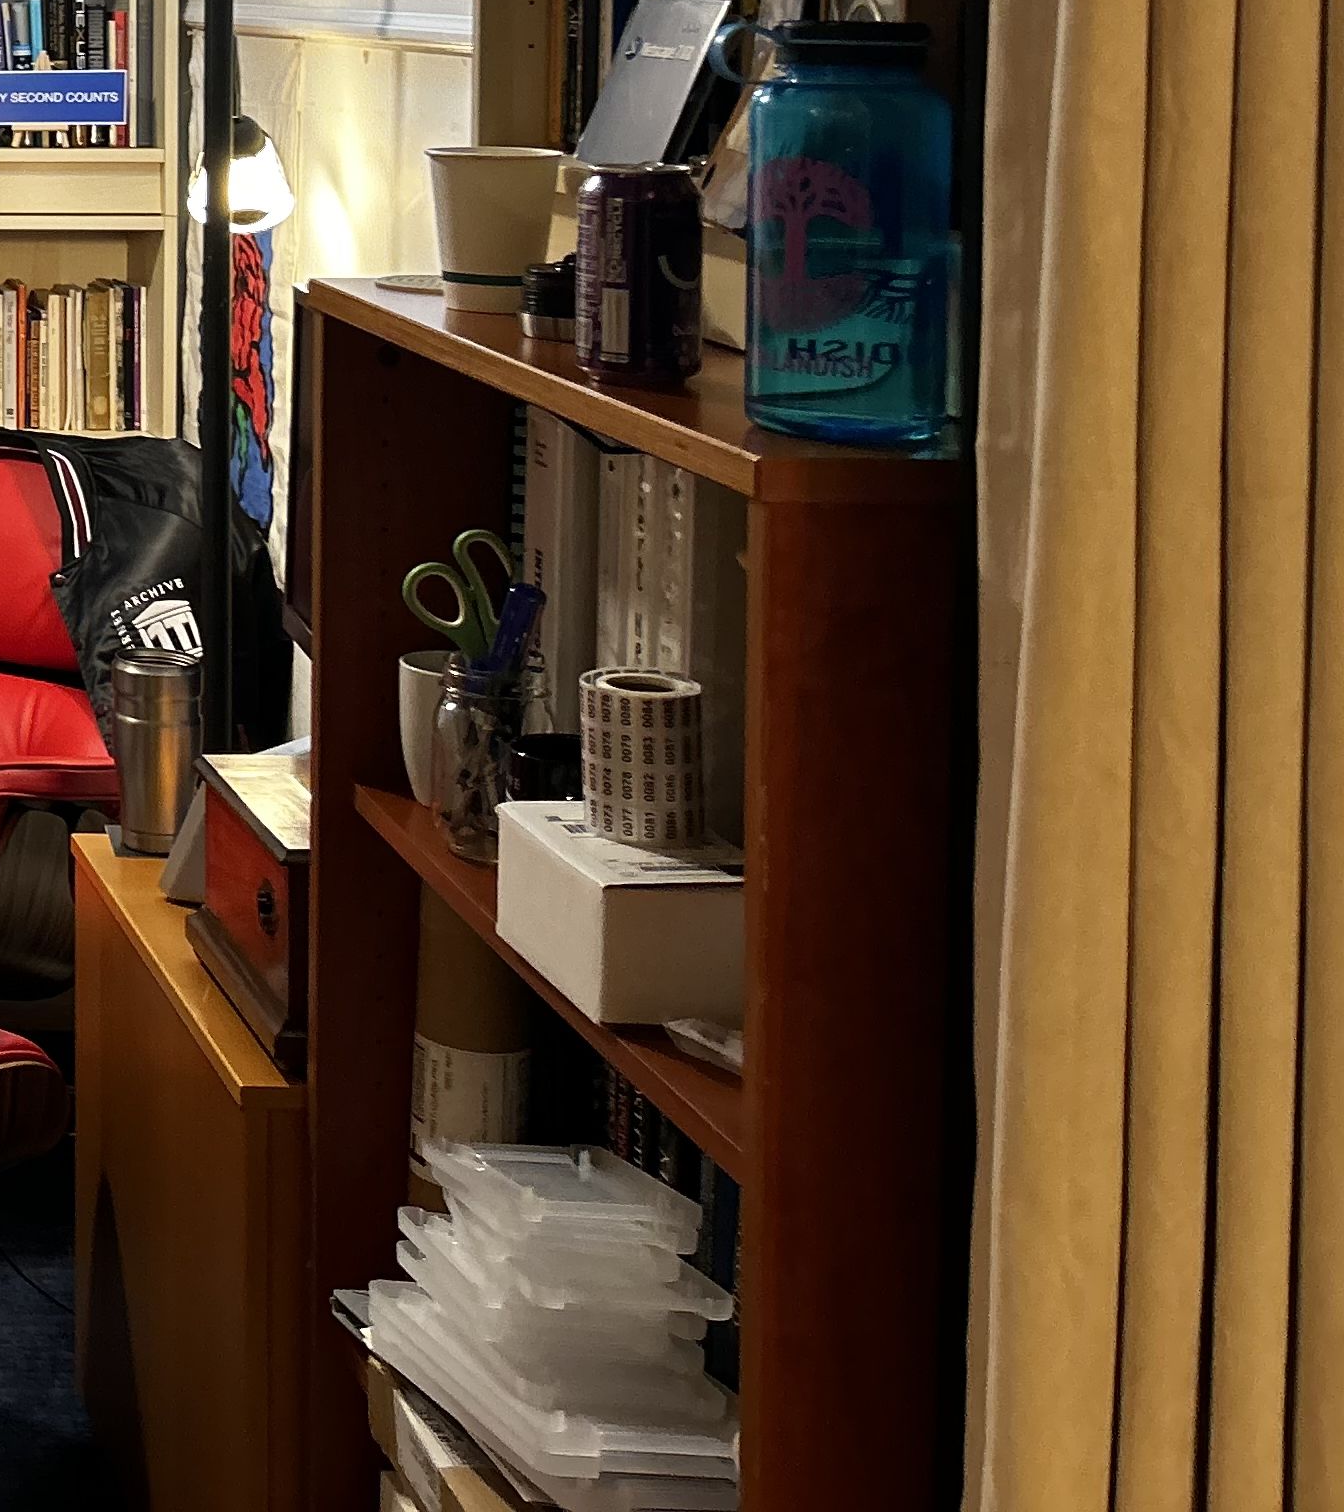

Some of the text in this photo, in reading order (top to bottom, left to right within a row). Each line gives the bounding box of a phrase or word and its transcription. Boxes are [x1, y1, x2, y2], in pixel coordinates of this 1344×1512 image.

[88, 10, 104, 49] HIDDEN
[567, 9, 580, 38] ART
[10, 91, 63, 103] SECOND
[65, 91, 119, 103] COUNTS
[123, 578, 184, 610] ARCHIVE
[623, 808, 633, 837] 0077
